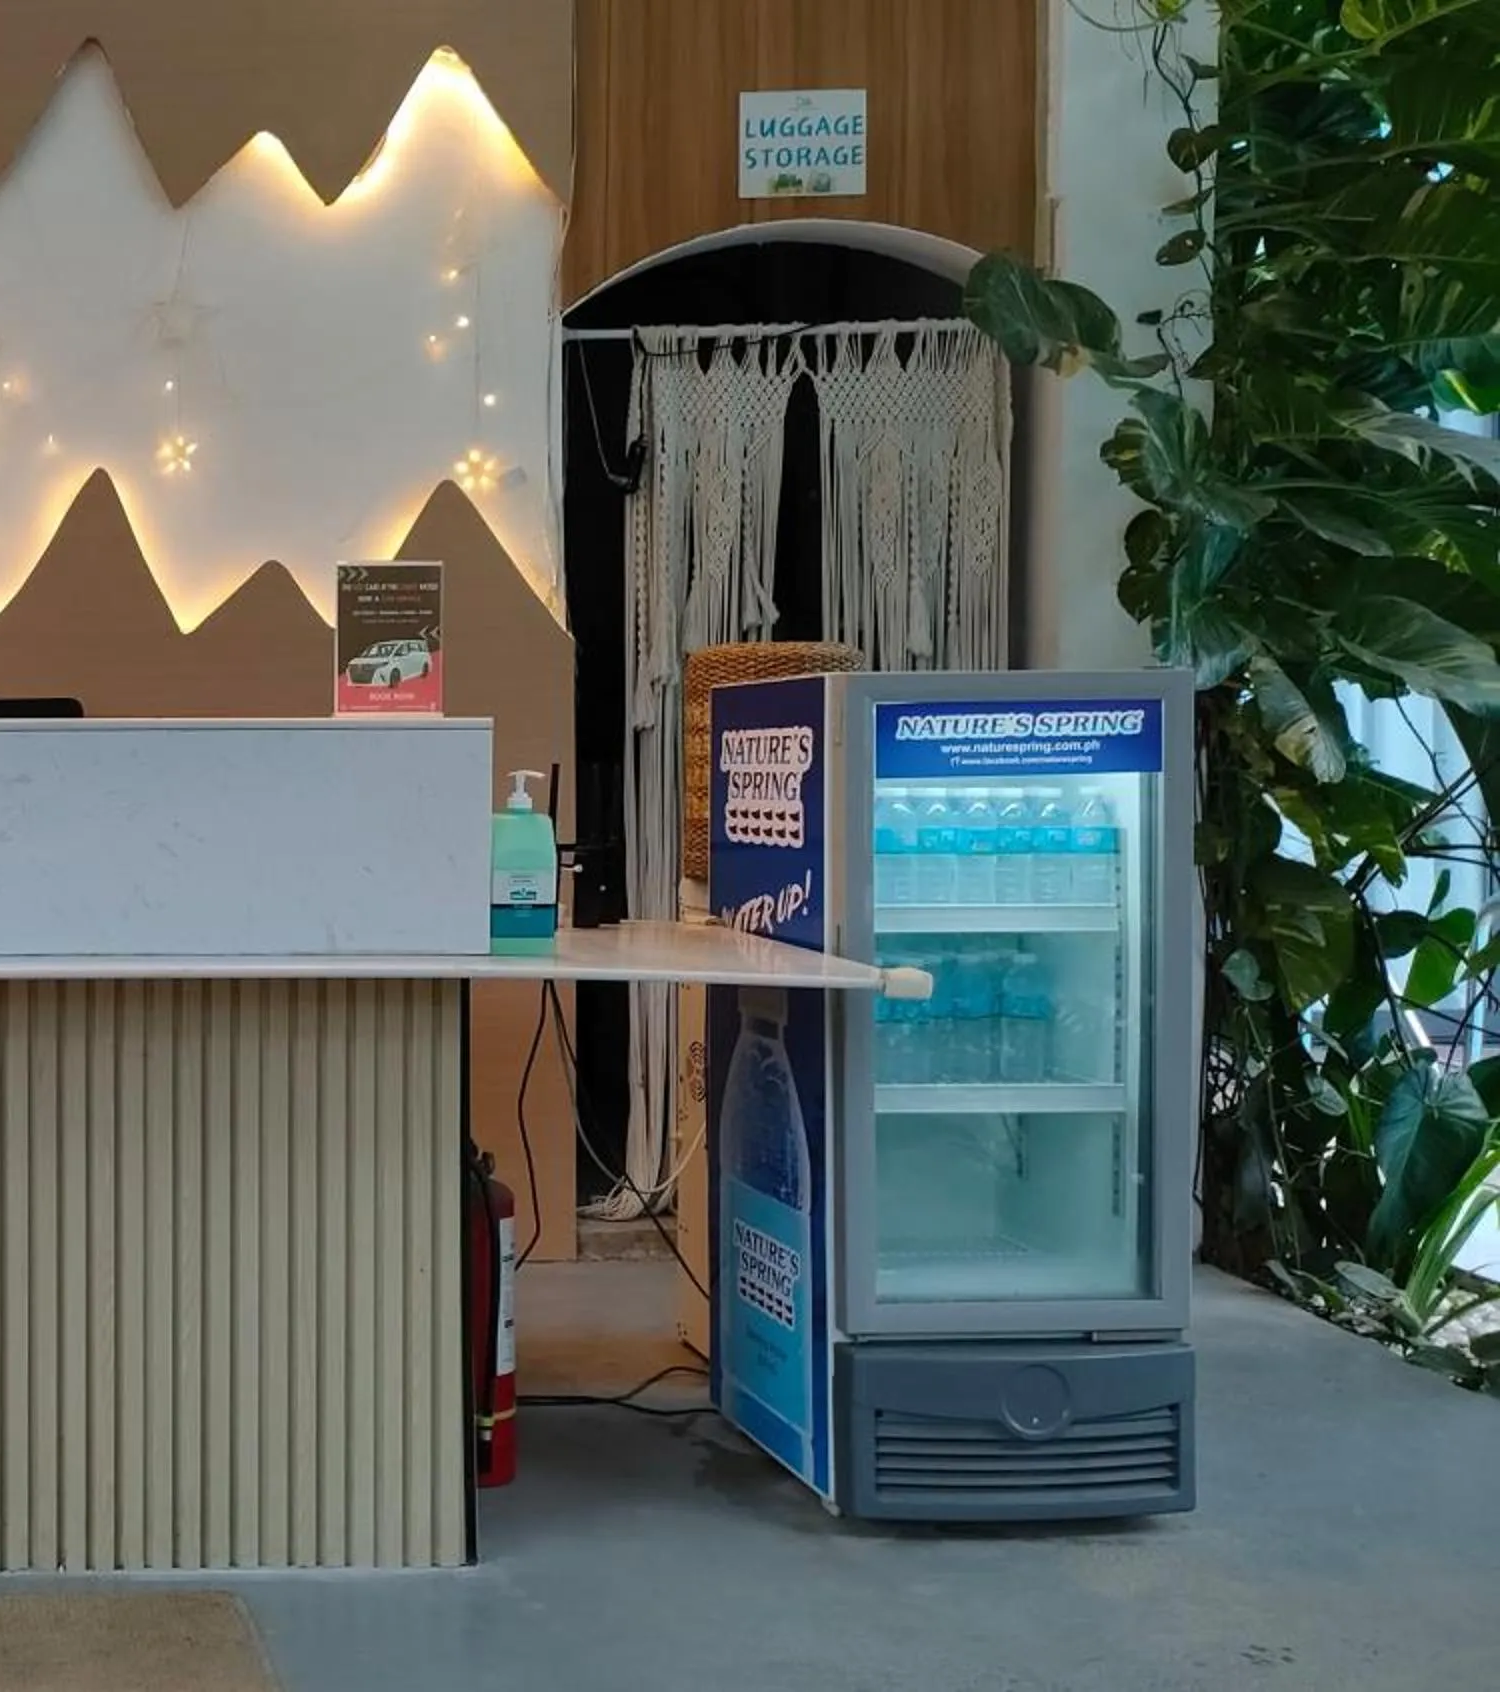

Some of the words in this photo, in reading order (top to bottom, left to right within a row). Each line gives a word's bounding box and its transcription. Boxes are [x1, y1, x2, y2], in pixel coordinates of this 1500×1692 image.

[744, 115, 865, 138] LUGGAGE
[744, 145, 864, 169] STORAGE
[897, 714, 1032, 739] NATURE'S
[1035, 710, 1144, 736] SPRING
[723, 733, 811, 765] NATURE'S
[940, 739, 1101, 754] www.naturespring.com.ph
[731, 771, 798, 801] SPRING
[777, 868, 812, 924] UP!
[734, 1221, 800, 1276] NATURE'S
[741, 1251, 792, 1297] SPRING
